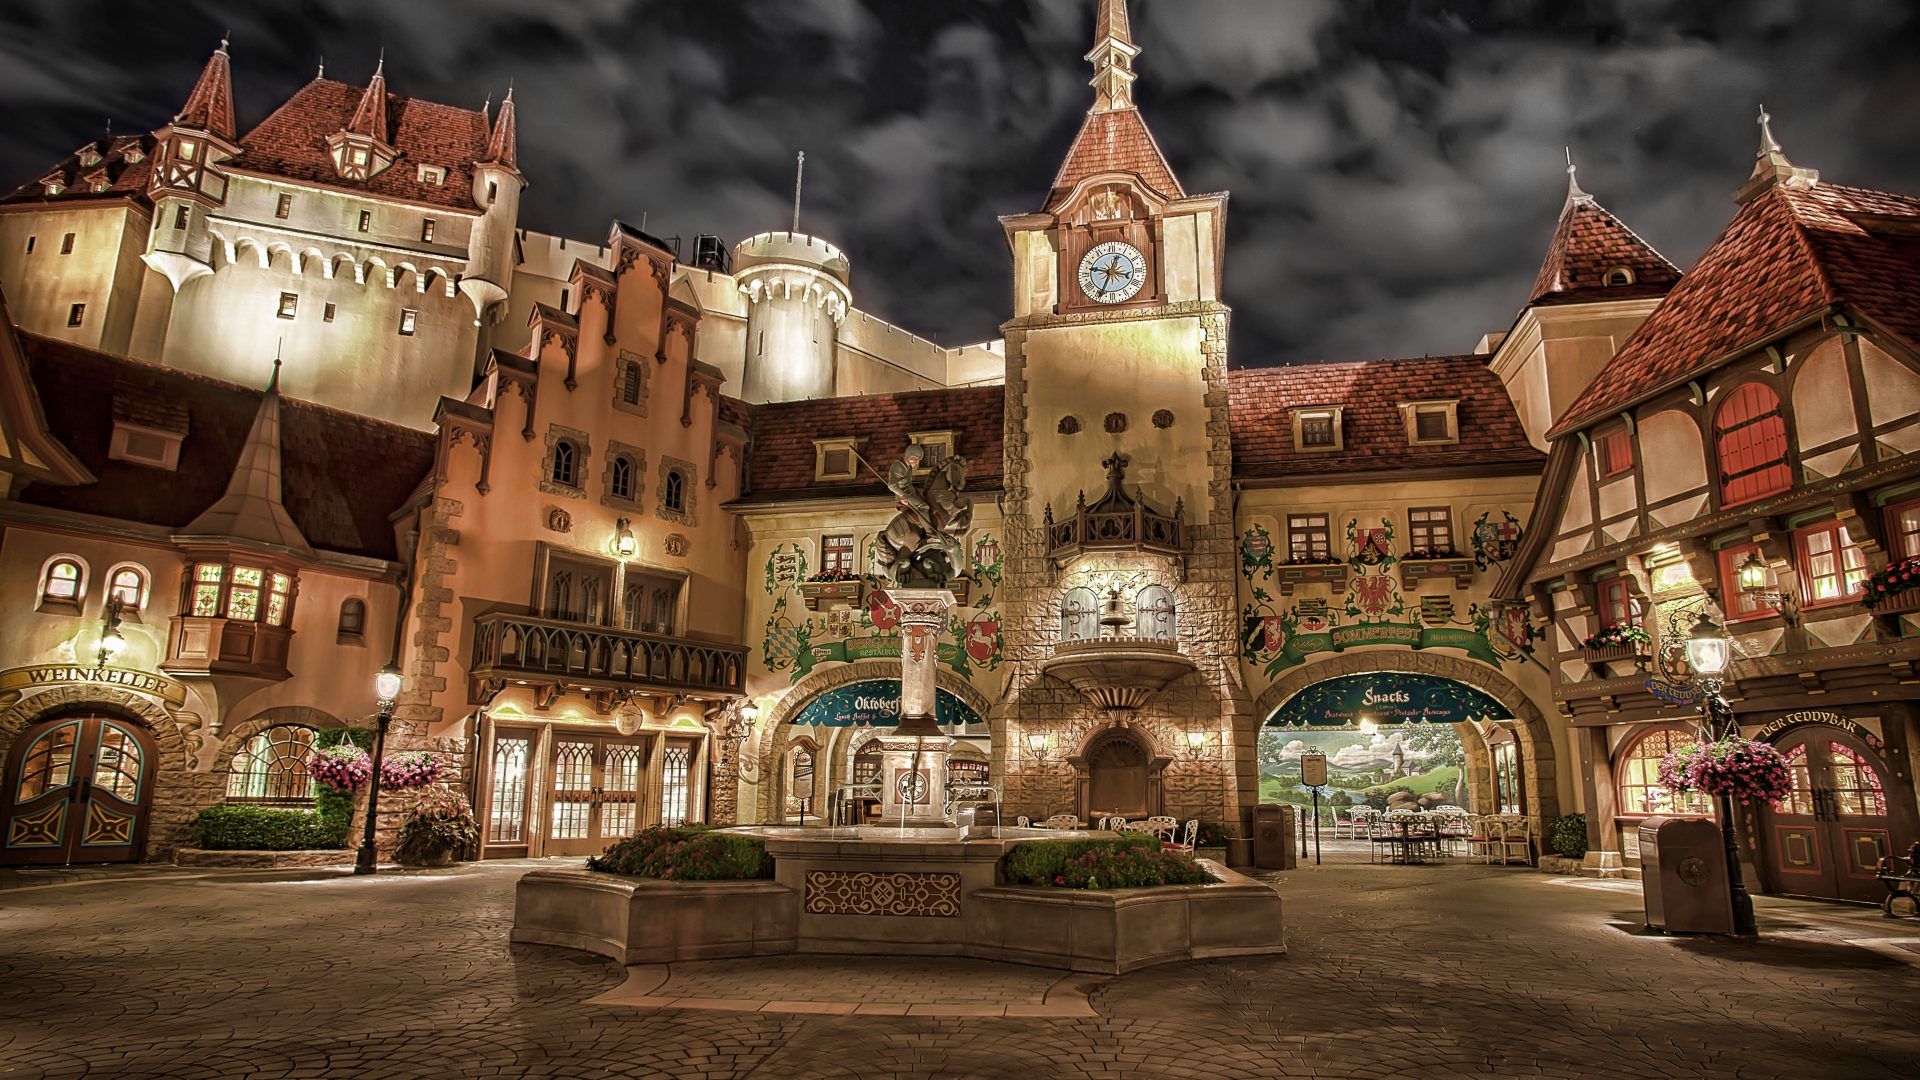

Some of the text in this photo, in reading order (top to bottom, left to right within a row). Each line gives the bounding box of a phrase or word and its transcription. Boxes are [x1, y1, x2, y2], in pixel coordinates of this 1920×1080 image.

[847, 637, 902, 650] BIERGAR
[1333, 627, 1422, 645] SOMMERFEST
[859, 648, 901, 657] RESTAURAN
[28, 668, 169, 693] WEINKELLER
[1362, 687, 1410, 706] Snacks
[1651, 682, 1711, 699] DER TEDDYB
[855, 696, 902, 717] Oktoberf
[1761, 711, 1857, 737] DER TEDDYBÄR
